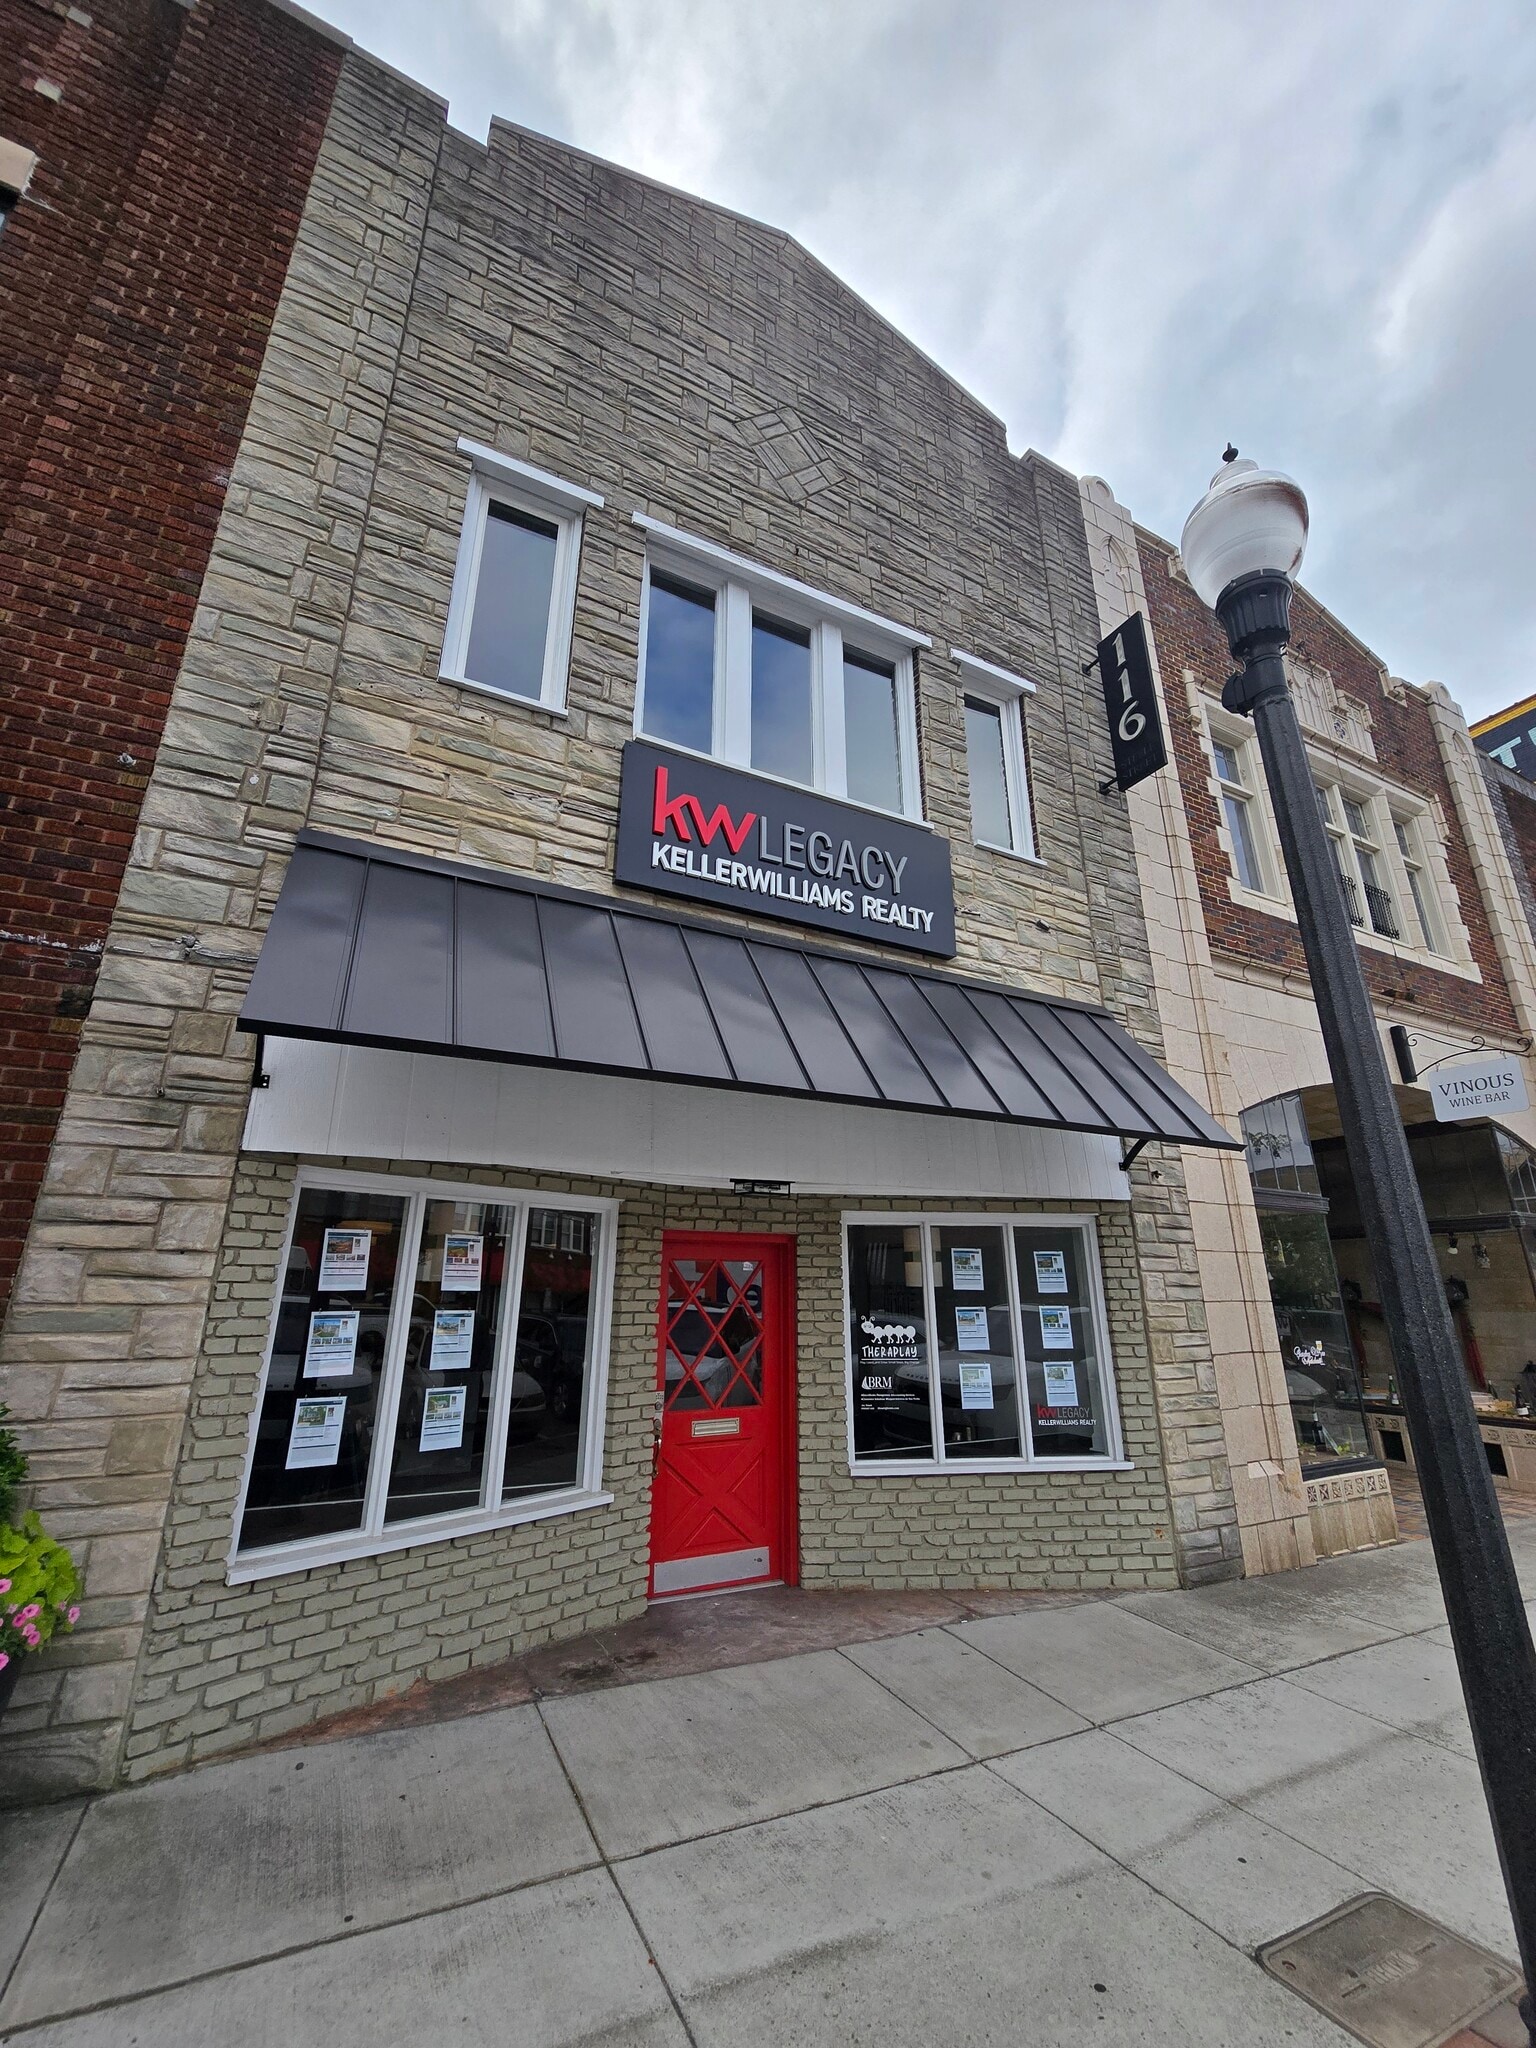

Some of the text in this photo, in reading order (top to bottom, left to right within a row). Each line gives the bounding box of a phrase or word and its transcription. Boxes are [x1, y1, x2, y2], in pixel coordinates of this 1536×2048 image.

[1112, 632, 1146, 741] 116
[653, 766, 908, 895] kw LEGACY
[862, 894, 934, 933] REALTY
[1439, 1073, 1514, 1096] VINOUS
[1449, 1091, 1510, 1108] WINE BAR
[861, 1345, 918, 1358] THERAPLAY
[1057, 1407, 1090, 1418] LEGACY
